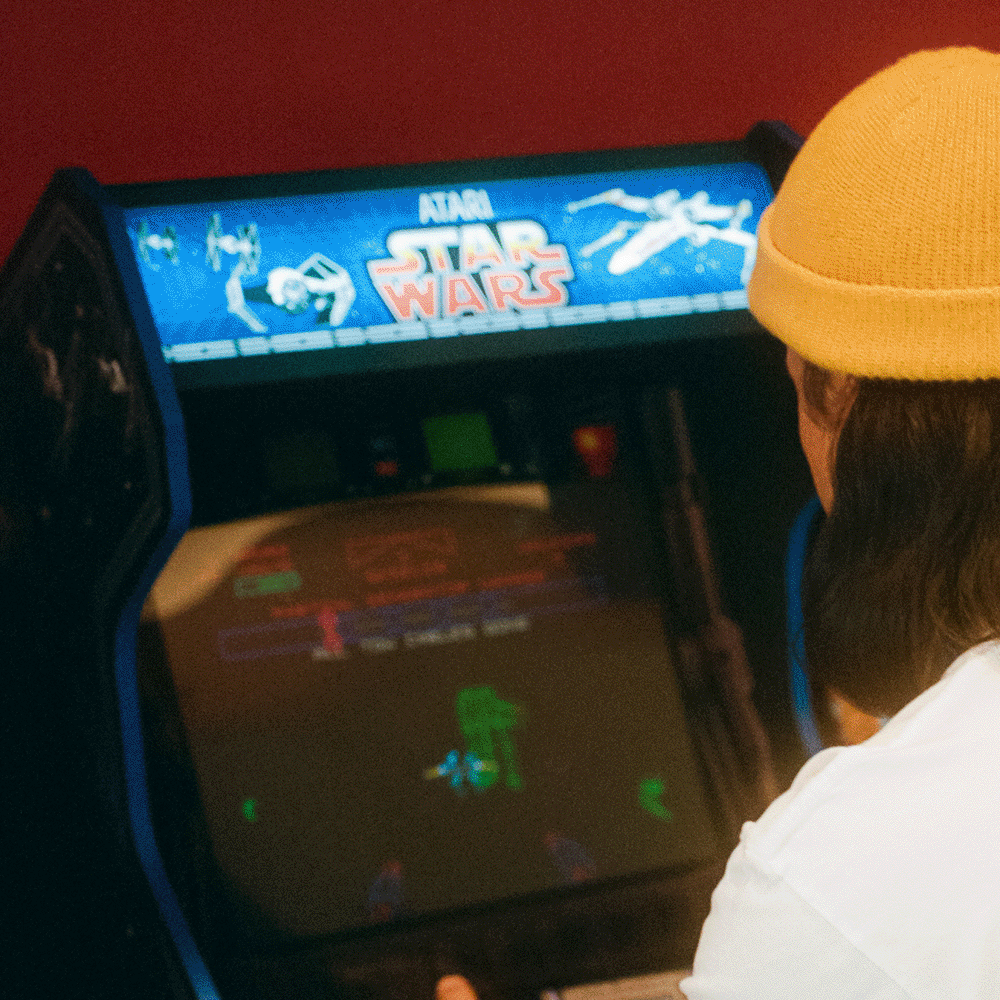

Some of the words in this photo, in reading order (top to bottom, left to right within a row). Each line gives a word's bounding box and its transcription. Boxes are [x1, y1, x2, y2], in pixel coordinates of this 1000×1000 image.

[420, 188, 493, 224] ATARI
[367, 219, 567, 279] STAR
[380, 264, 572, 321] WARS
